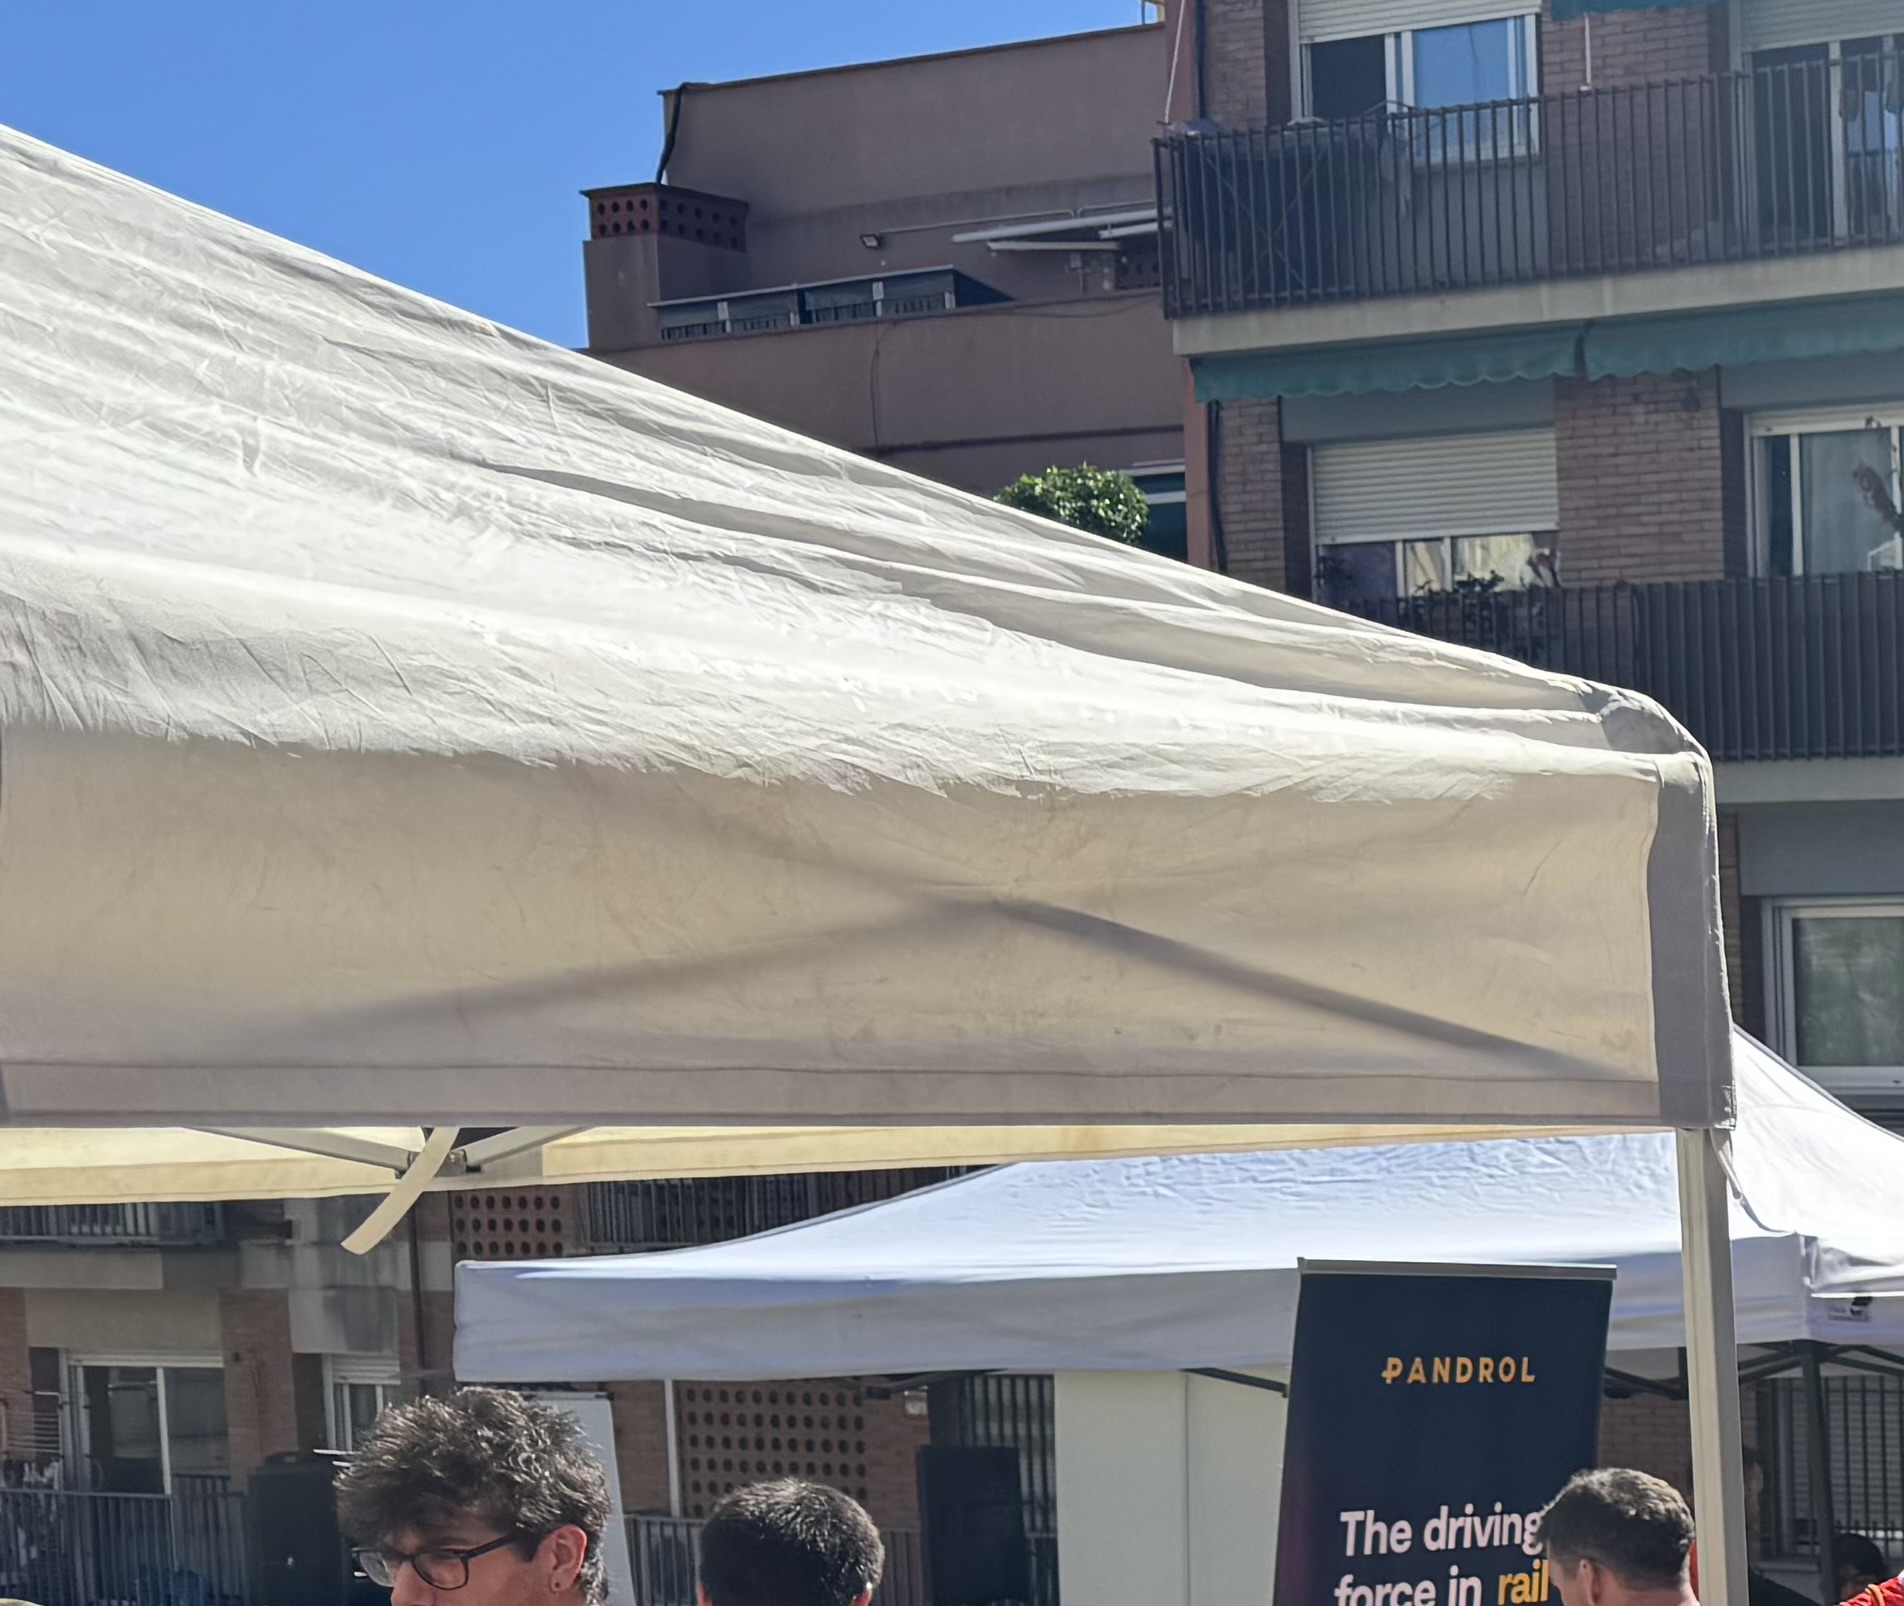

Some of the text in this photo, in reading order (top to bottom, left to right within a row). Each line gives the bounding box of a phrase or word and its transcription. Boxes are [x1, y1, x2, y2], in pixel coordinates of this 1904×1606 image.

[1382, 1356, 1536, 1384] PANDROL
[1340, 1503, 1544, 1557] The driving
[1498, 1561, 1549, 1606] rail
